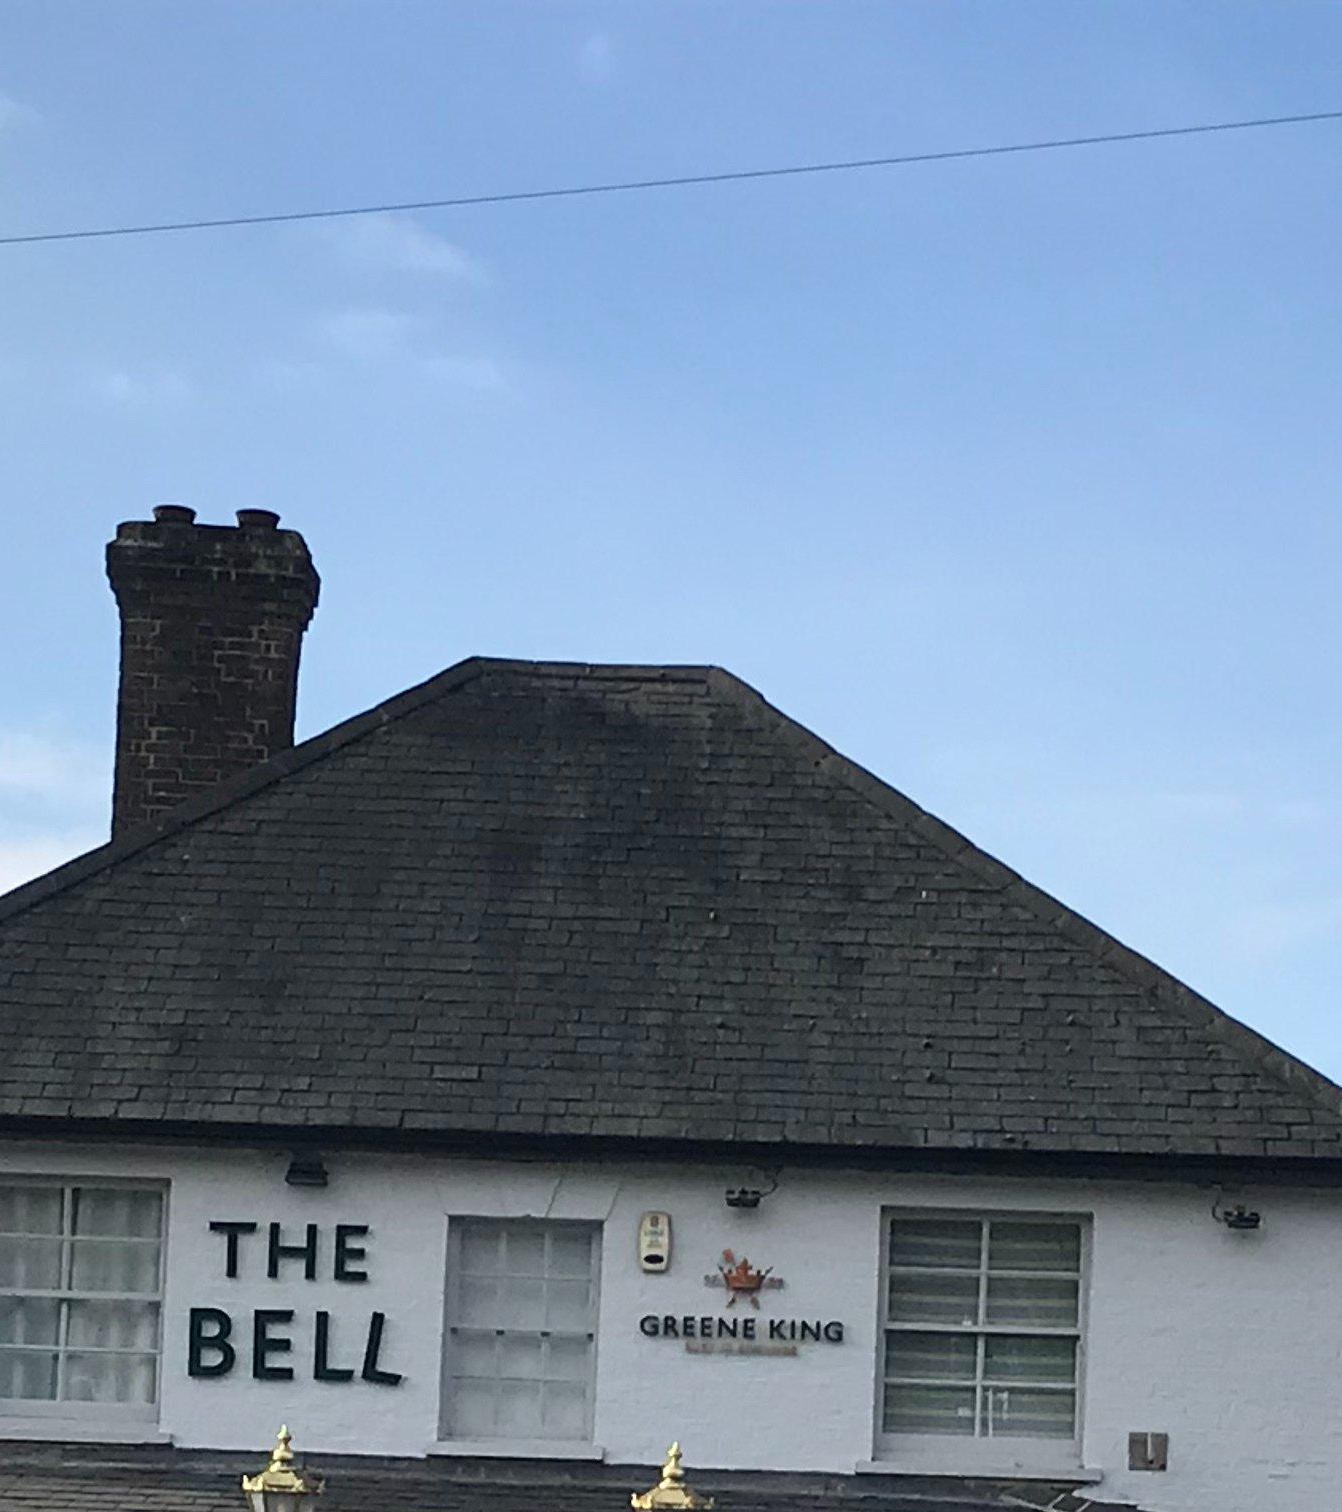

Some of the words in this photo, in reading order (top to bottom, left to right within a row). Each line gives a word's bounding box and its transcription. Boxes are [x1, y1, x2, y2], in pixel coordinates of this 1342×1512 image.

[209, 1221, 370, 1282] THE
[188, 1307, 403, 1386] BELL
[640, 1315, 757, 1341] GREENE
[769, 1318, 844, 1343] KING
